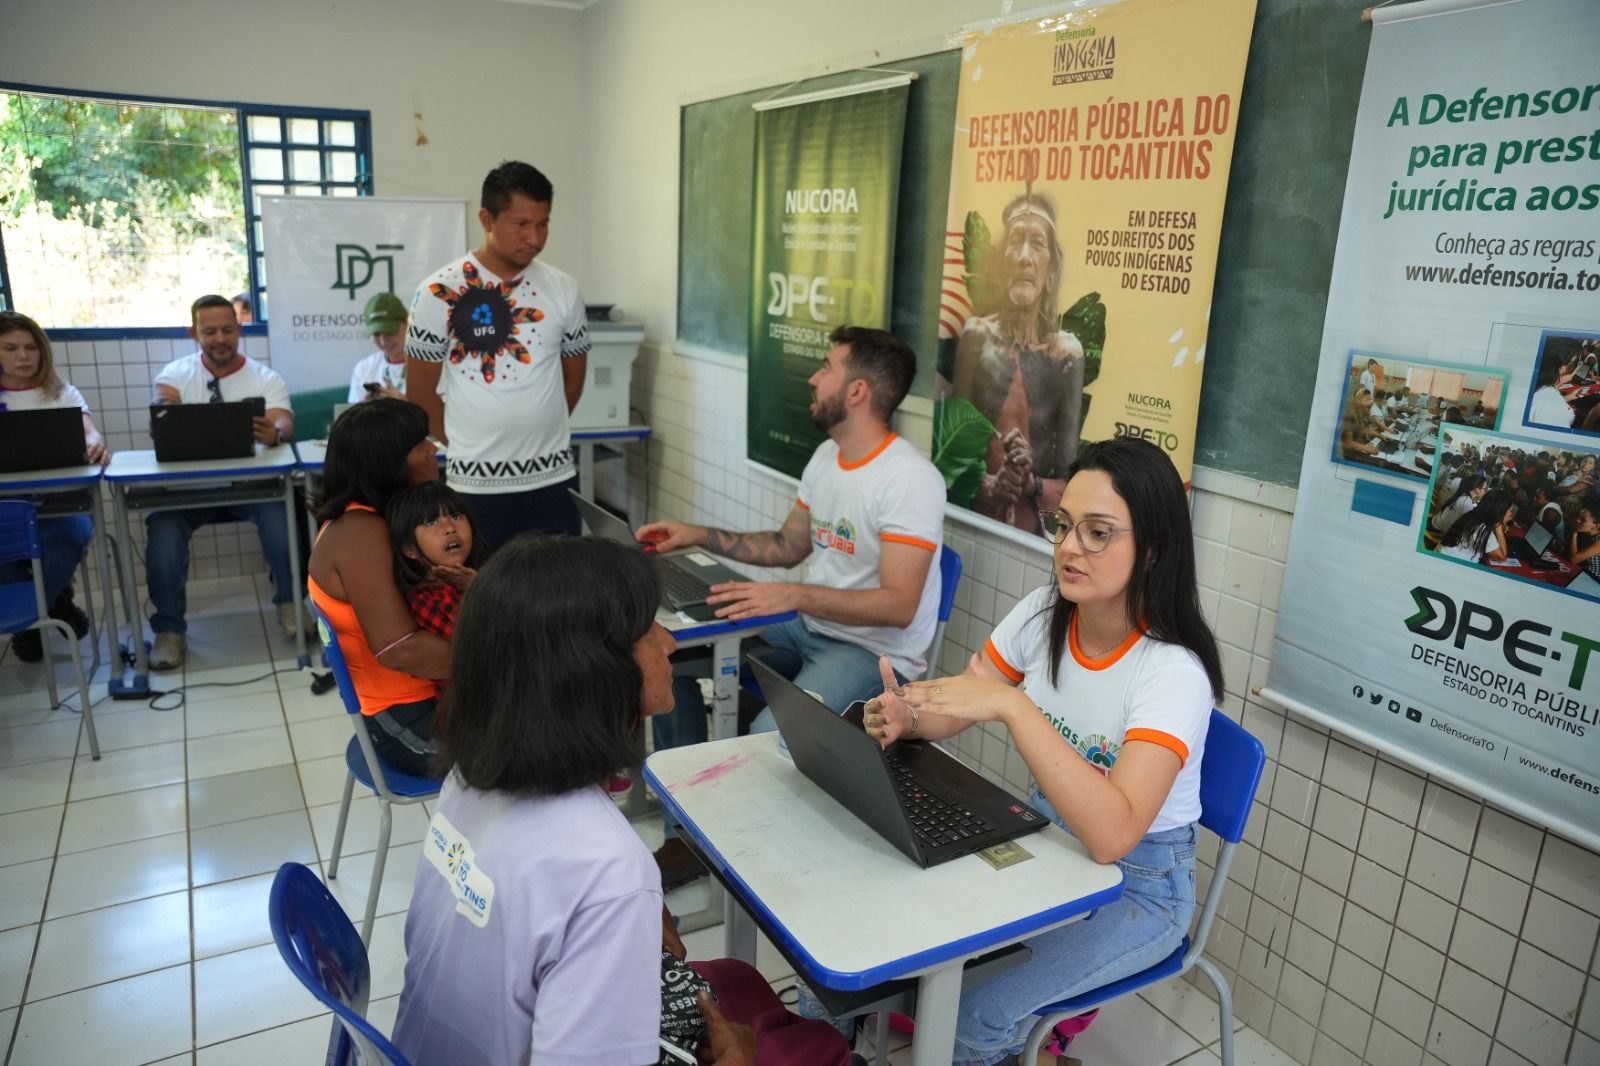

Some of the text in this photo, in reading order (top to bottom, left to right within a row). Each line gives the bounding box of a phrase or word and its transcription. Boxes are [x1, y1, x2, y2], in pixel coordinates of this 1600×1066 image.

[1055, 25, 1096, 42] Defensoria
[1387, 82, 1600, 127] A Defensor
[969, 93, 1231, 149] DEFENSORIA PÚBLICA DO
[975, 140, 1213, 183] ESTADO DO TOCANTINS
[1407, 128, 1600, 177] para prest
[785, 186, 859, 215] NUCORA
[1383, 178, 1600, 220] jurídica aos
[1128, 210, 1197, 231] EM DEFESA
[1087, 229, 1195, 252] DOS DIREITOS DOS
[1435, 232, 1596, 263] Conheça as regras
[1085, 250, 1193, 274] POVOS INDÍGENAS
[1121, 272, 1190, 295] DO ESTADO
[1406, 263, 1600, 292] www.defensoria.to
[473, 325, 496, 337] UFG
[1128, 392, 1172, 411] NUCORA
[1410, 643, 1600, 727] DEFENSORIA PÚBLI
[1442, 675, 1585, 738] ESTADO DO TOCANTINS
[1430, 717, 1495, 752] DefensoriaTO
[464, 885, 487, 911] TINS
